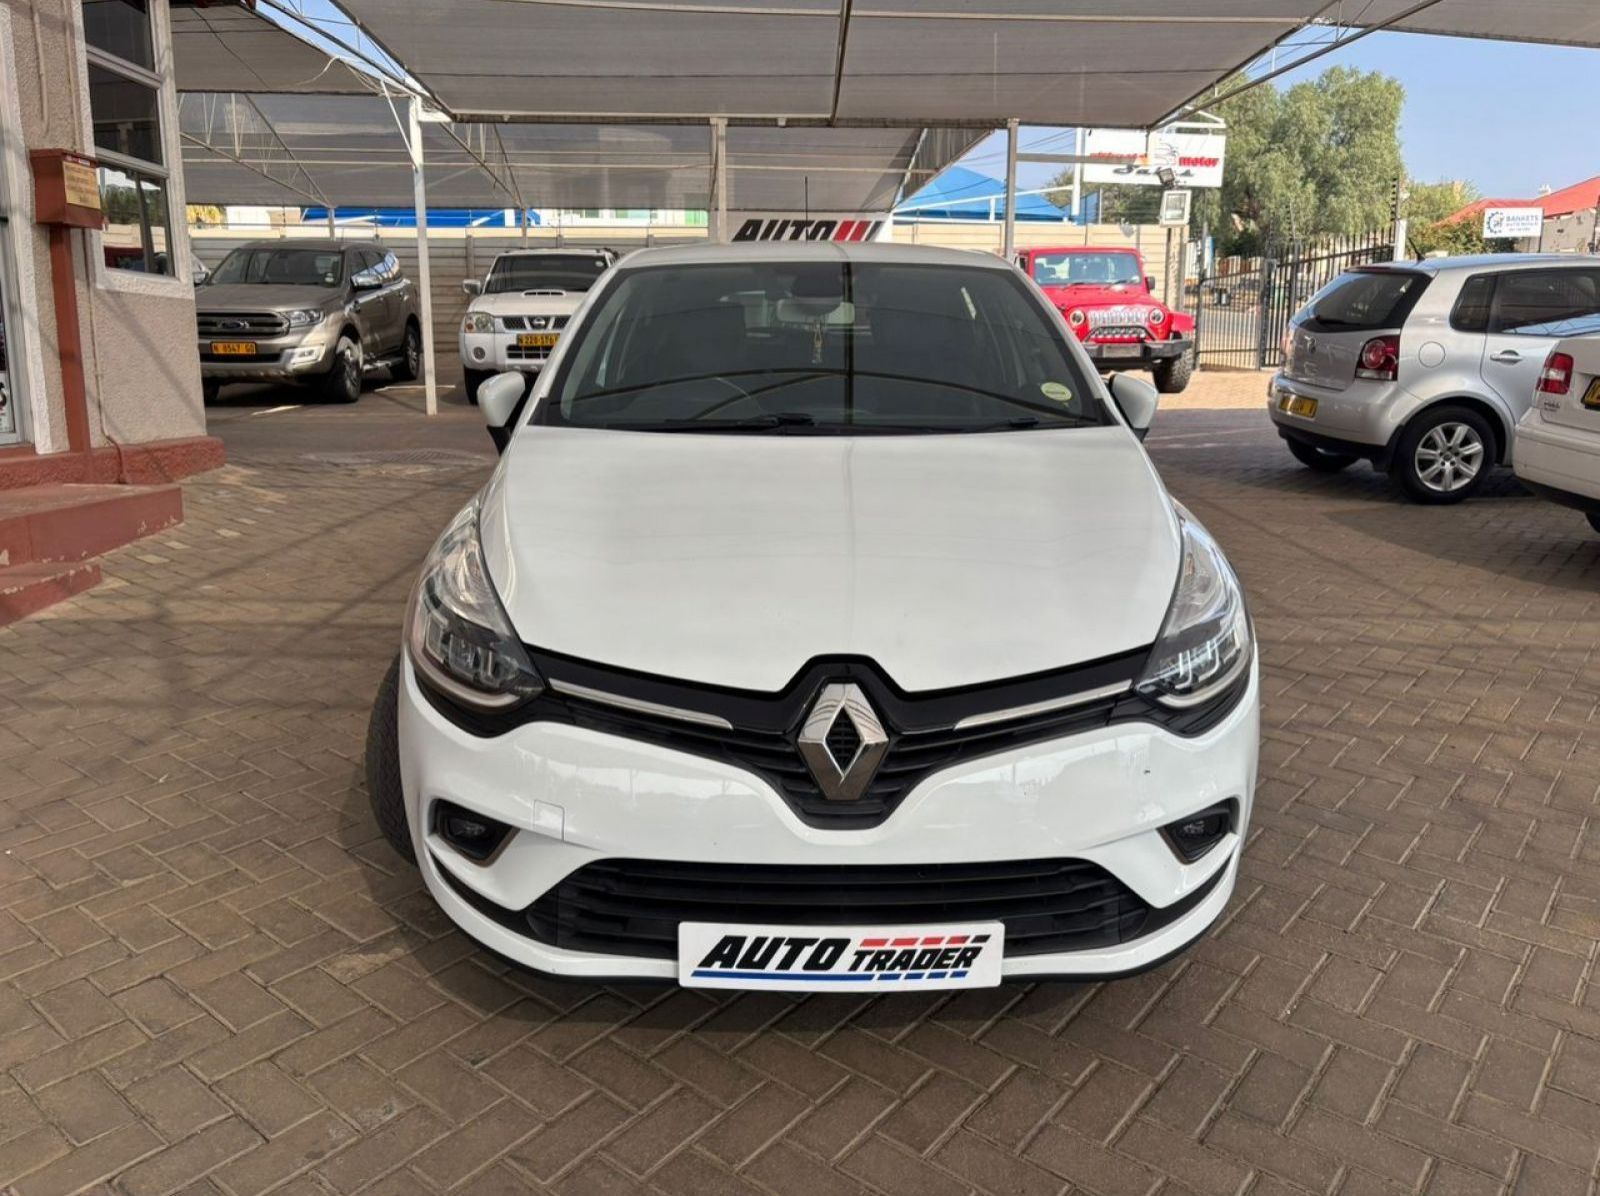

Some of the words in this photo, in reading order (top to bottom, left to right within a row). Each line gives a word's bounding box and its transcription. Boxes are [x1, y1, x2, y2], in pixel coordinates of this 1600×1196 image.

[1179, 156, 1219, 167] motor
[697, 935, 851, 971] AUTO
[847, 946, 983, 972] TRADER
